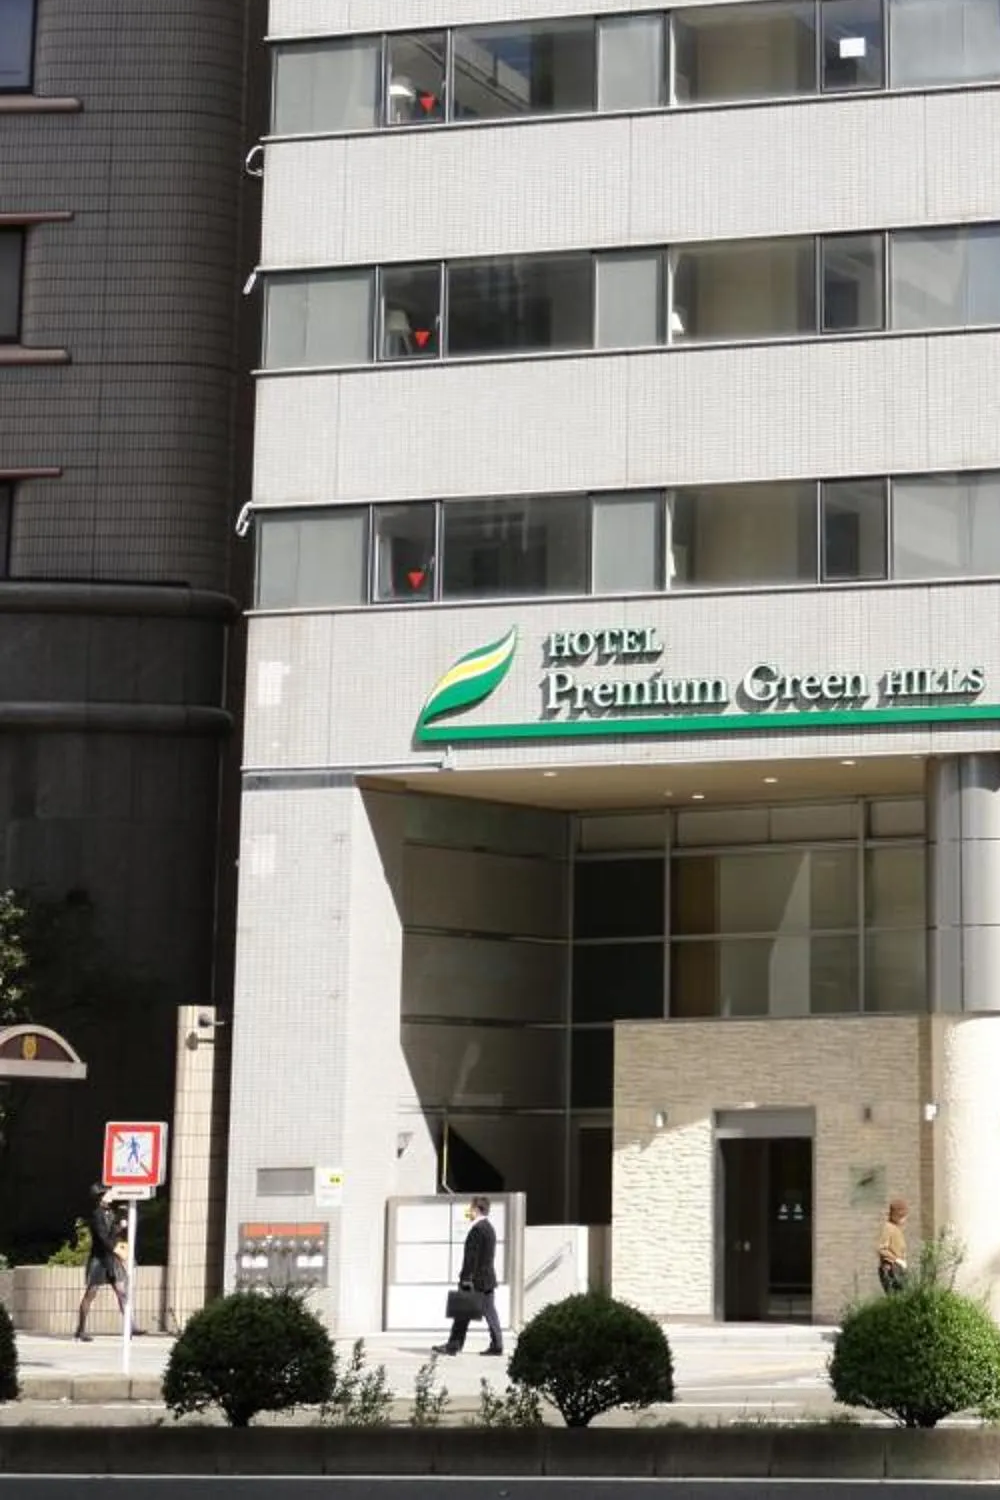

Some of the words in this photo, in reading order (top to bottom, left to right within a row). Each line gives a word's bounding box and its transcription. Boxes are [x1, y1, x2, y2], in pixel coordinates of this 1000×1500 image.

[549, 627, 663, 657] HOTEL
[546, 668, 728, 709] Premium
[743, 662, 869, 701] Green
[884, 666, 985, 696] HILLS
